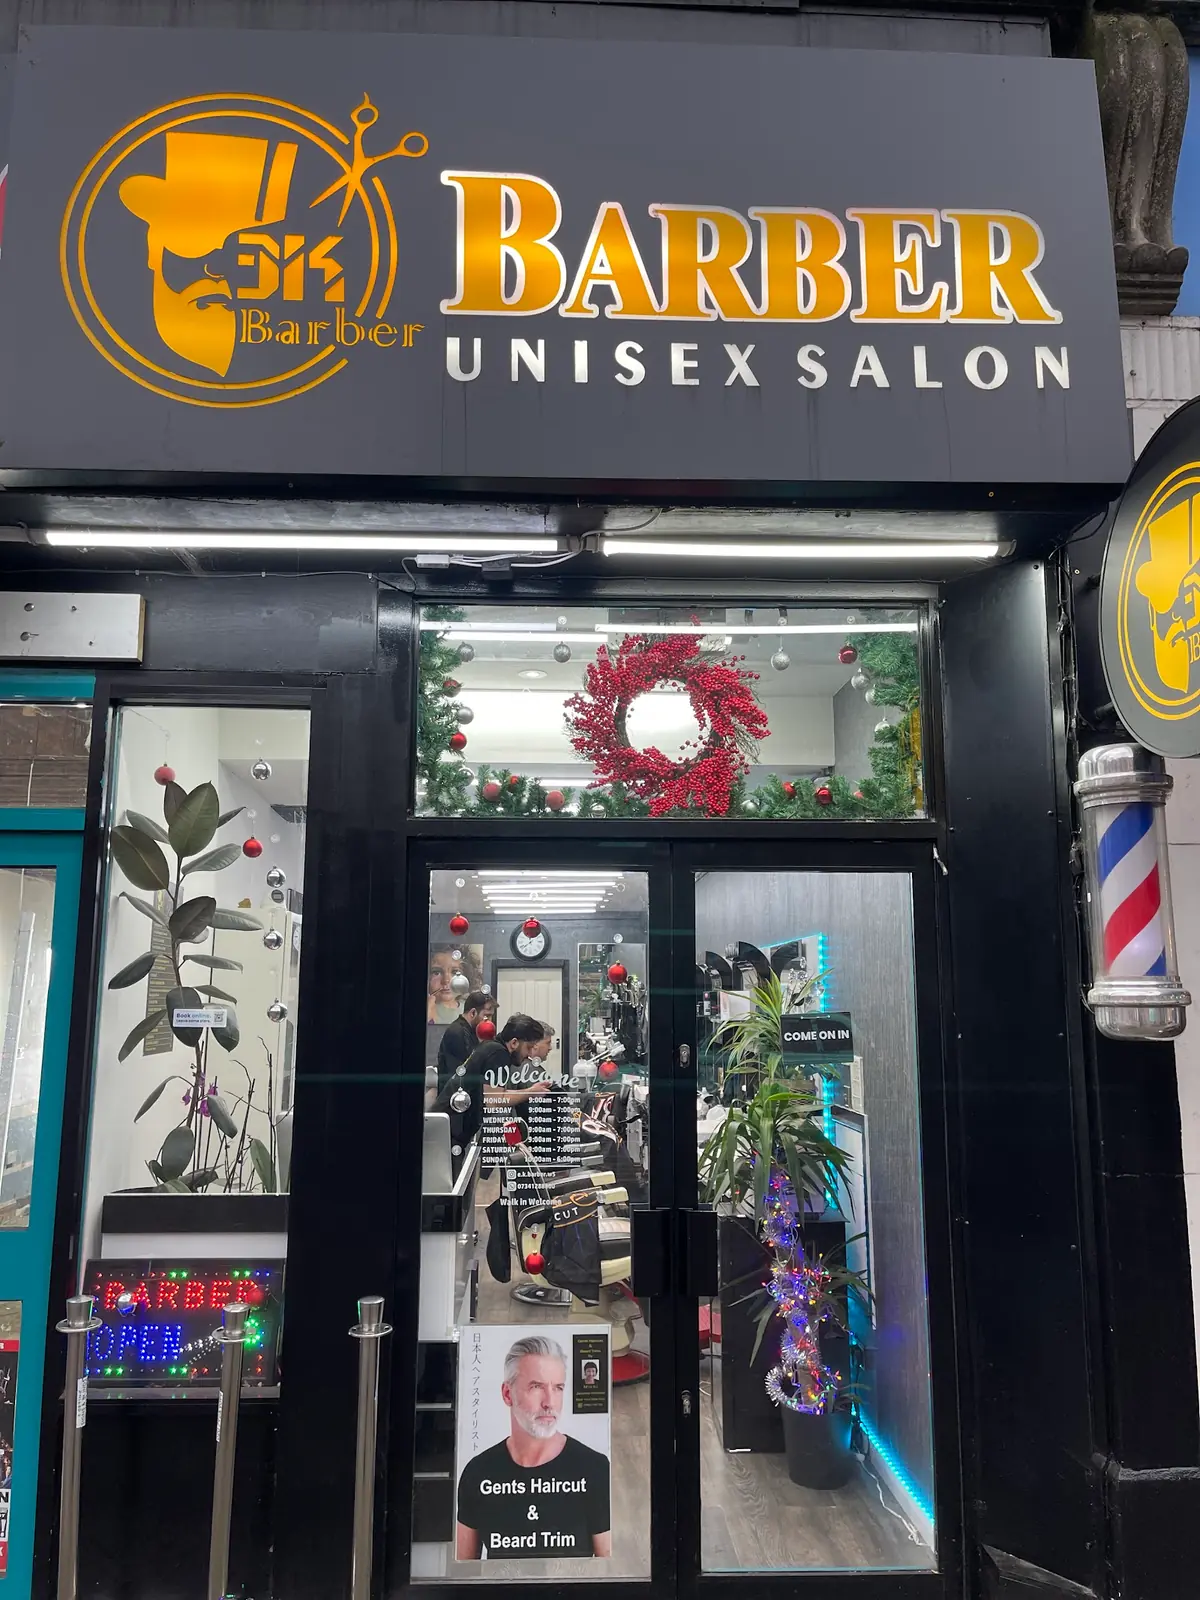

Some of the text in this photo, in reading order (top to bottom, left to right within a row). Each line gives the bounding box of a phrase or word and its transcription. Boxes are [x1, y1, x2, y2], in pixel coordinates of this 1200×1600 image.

[440, 170, 1063, 324] BARBER
[240, 307, 425, 347] Barber
[446, 337, 1070, 389] UNISEX SALON
[784, 1030, 849, 1042] COME ON IN
[485, 1063, 579, 1088] Welcome
[500, 1198, 519, 1206] Walk
[520, 1198, 527, 1206] in
[554, 1207, 578, 1221] CUT
[104, 1281, 258, 1310] BARBER
[96, 1325, 182, 1360] OPEN
[480, 1477, 587, 1495] Gents Haircut
[527, 1505, 539, 1521] &
[490, 1532, 576, 1549] Beard Trim
